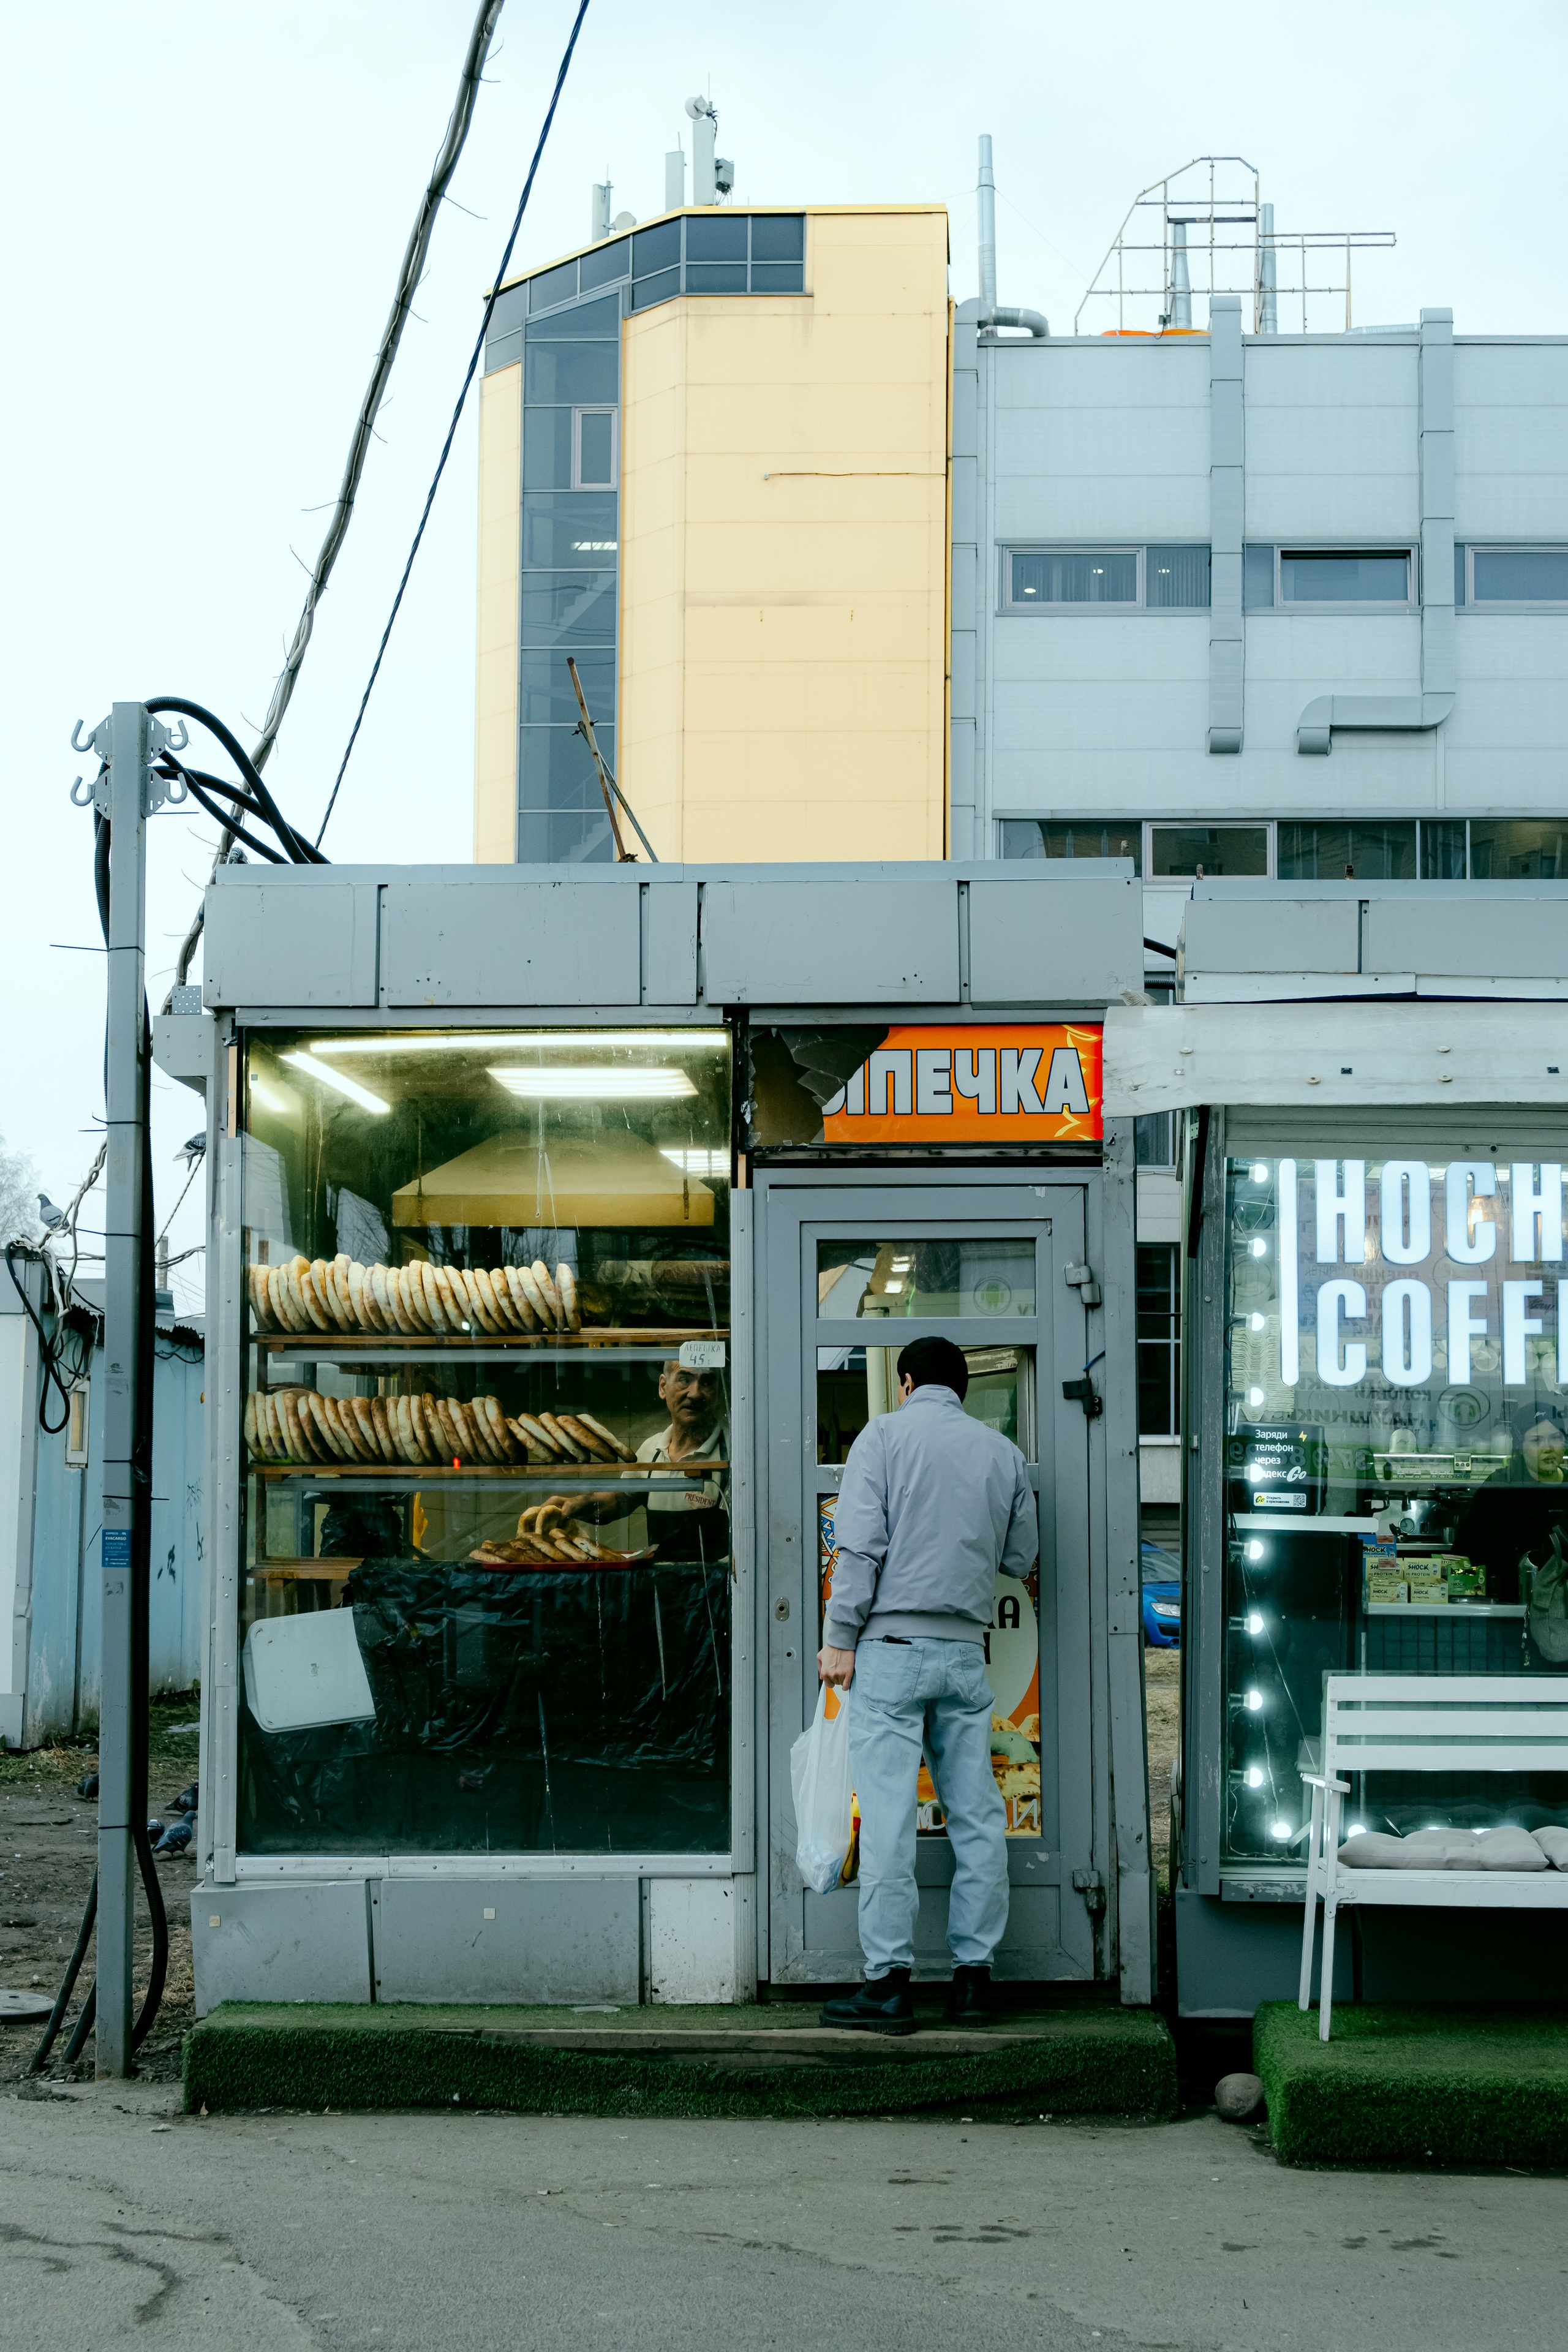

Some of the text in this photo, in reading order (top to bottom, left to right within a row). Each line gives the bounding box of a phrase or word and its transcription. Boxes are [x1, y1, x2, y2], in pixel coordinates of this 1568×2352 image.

[690, 1354, 705, 1365] 45
[1255, 1429, 1288, 1440] Заряди
[1255, 1442, 1294, 1453] телефон
[1254, 1457, 1281, 1465] через
[1262, 1466, 1307, 1482] декс Go
